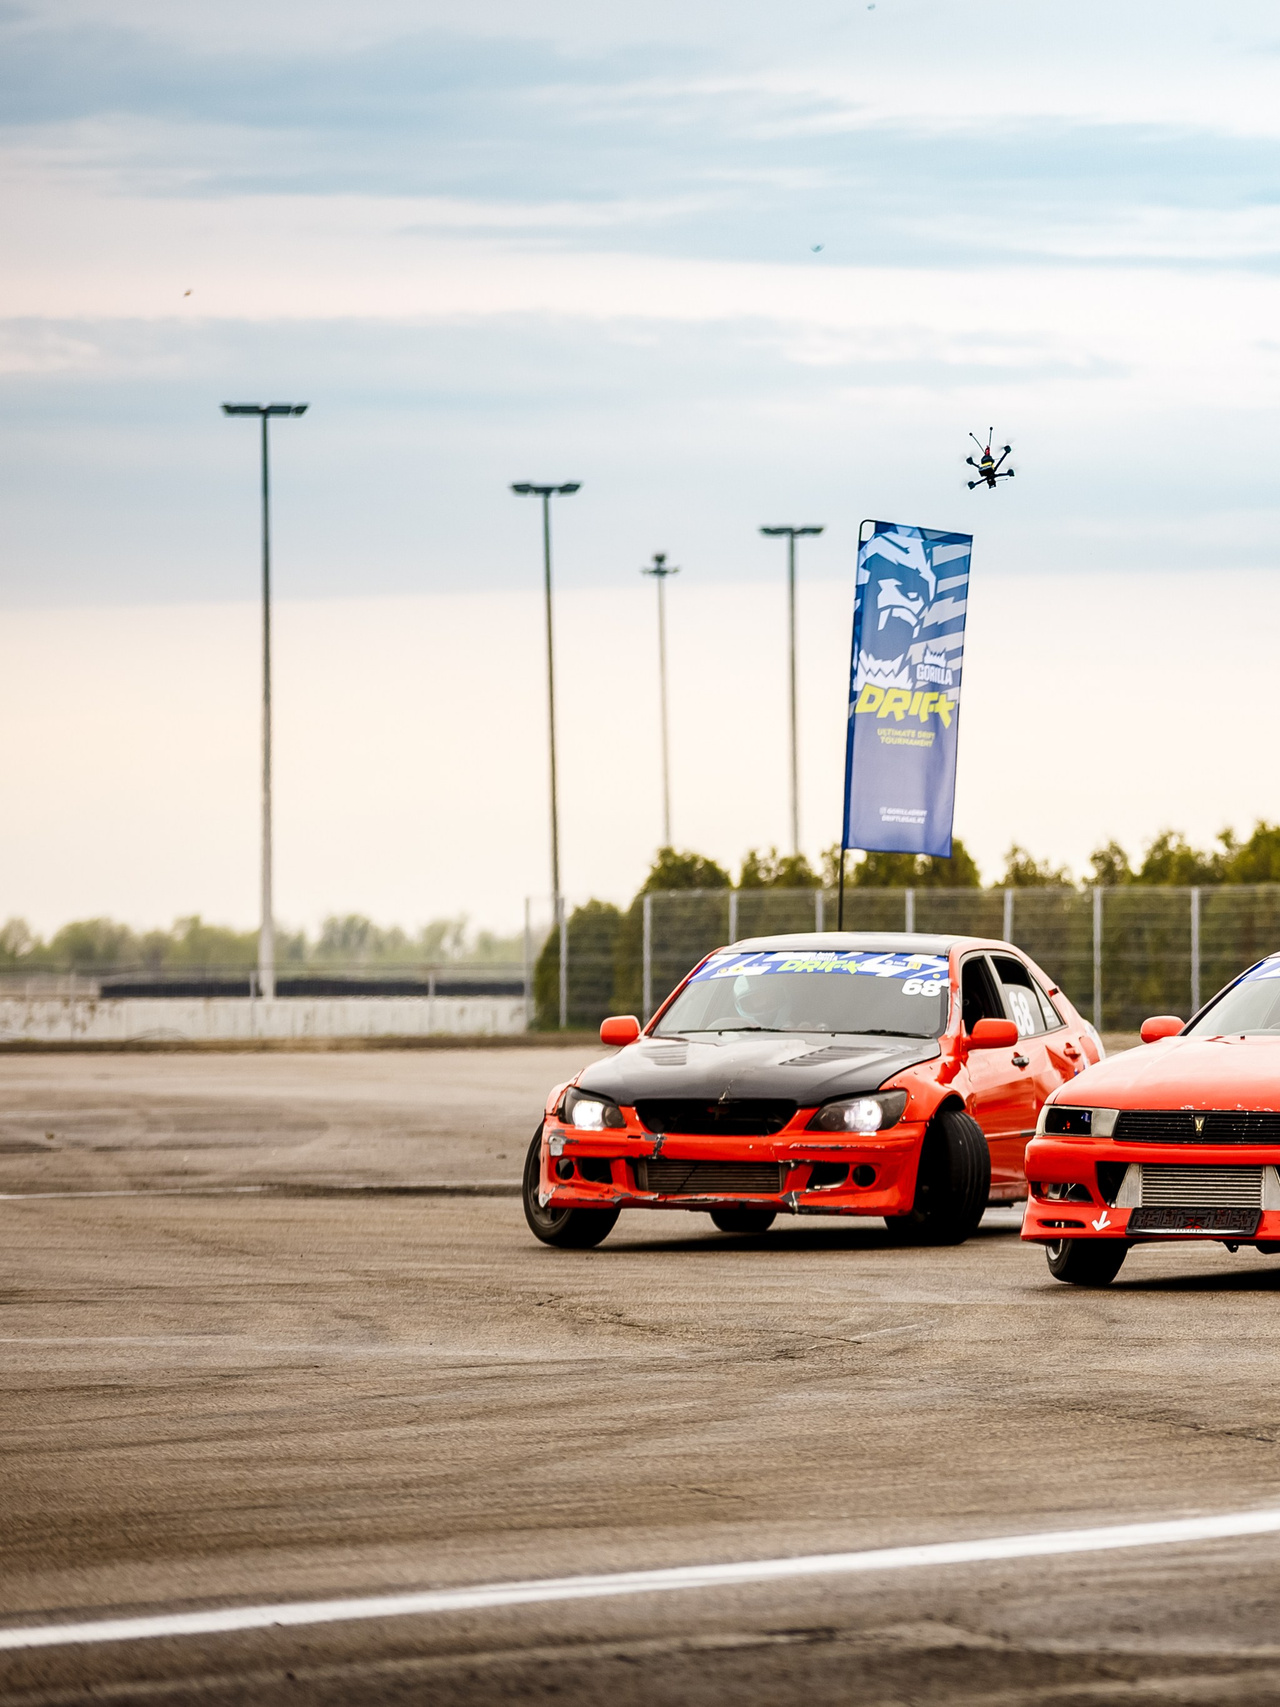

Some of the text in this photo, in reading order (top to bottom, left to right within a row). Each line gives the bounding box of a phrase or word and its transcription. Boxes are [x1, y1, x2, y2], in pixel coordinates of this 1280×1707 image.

[916, 664, 953, 685] GORILLA
[855, 683, 955, 729] DRIFT
[877, 728, 916, 738] ULTIMATE
[880, 736, 934, 748] TOURNAMENT
[776, 959, 862, 974] DRIFT
[901, 978, 941, 997] 68
[1009, 991, 1035, 1037] 68
